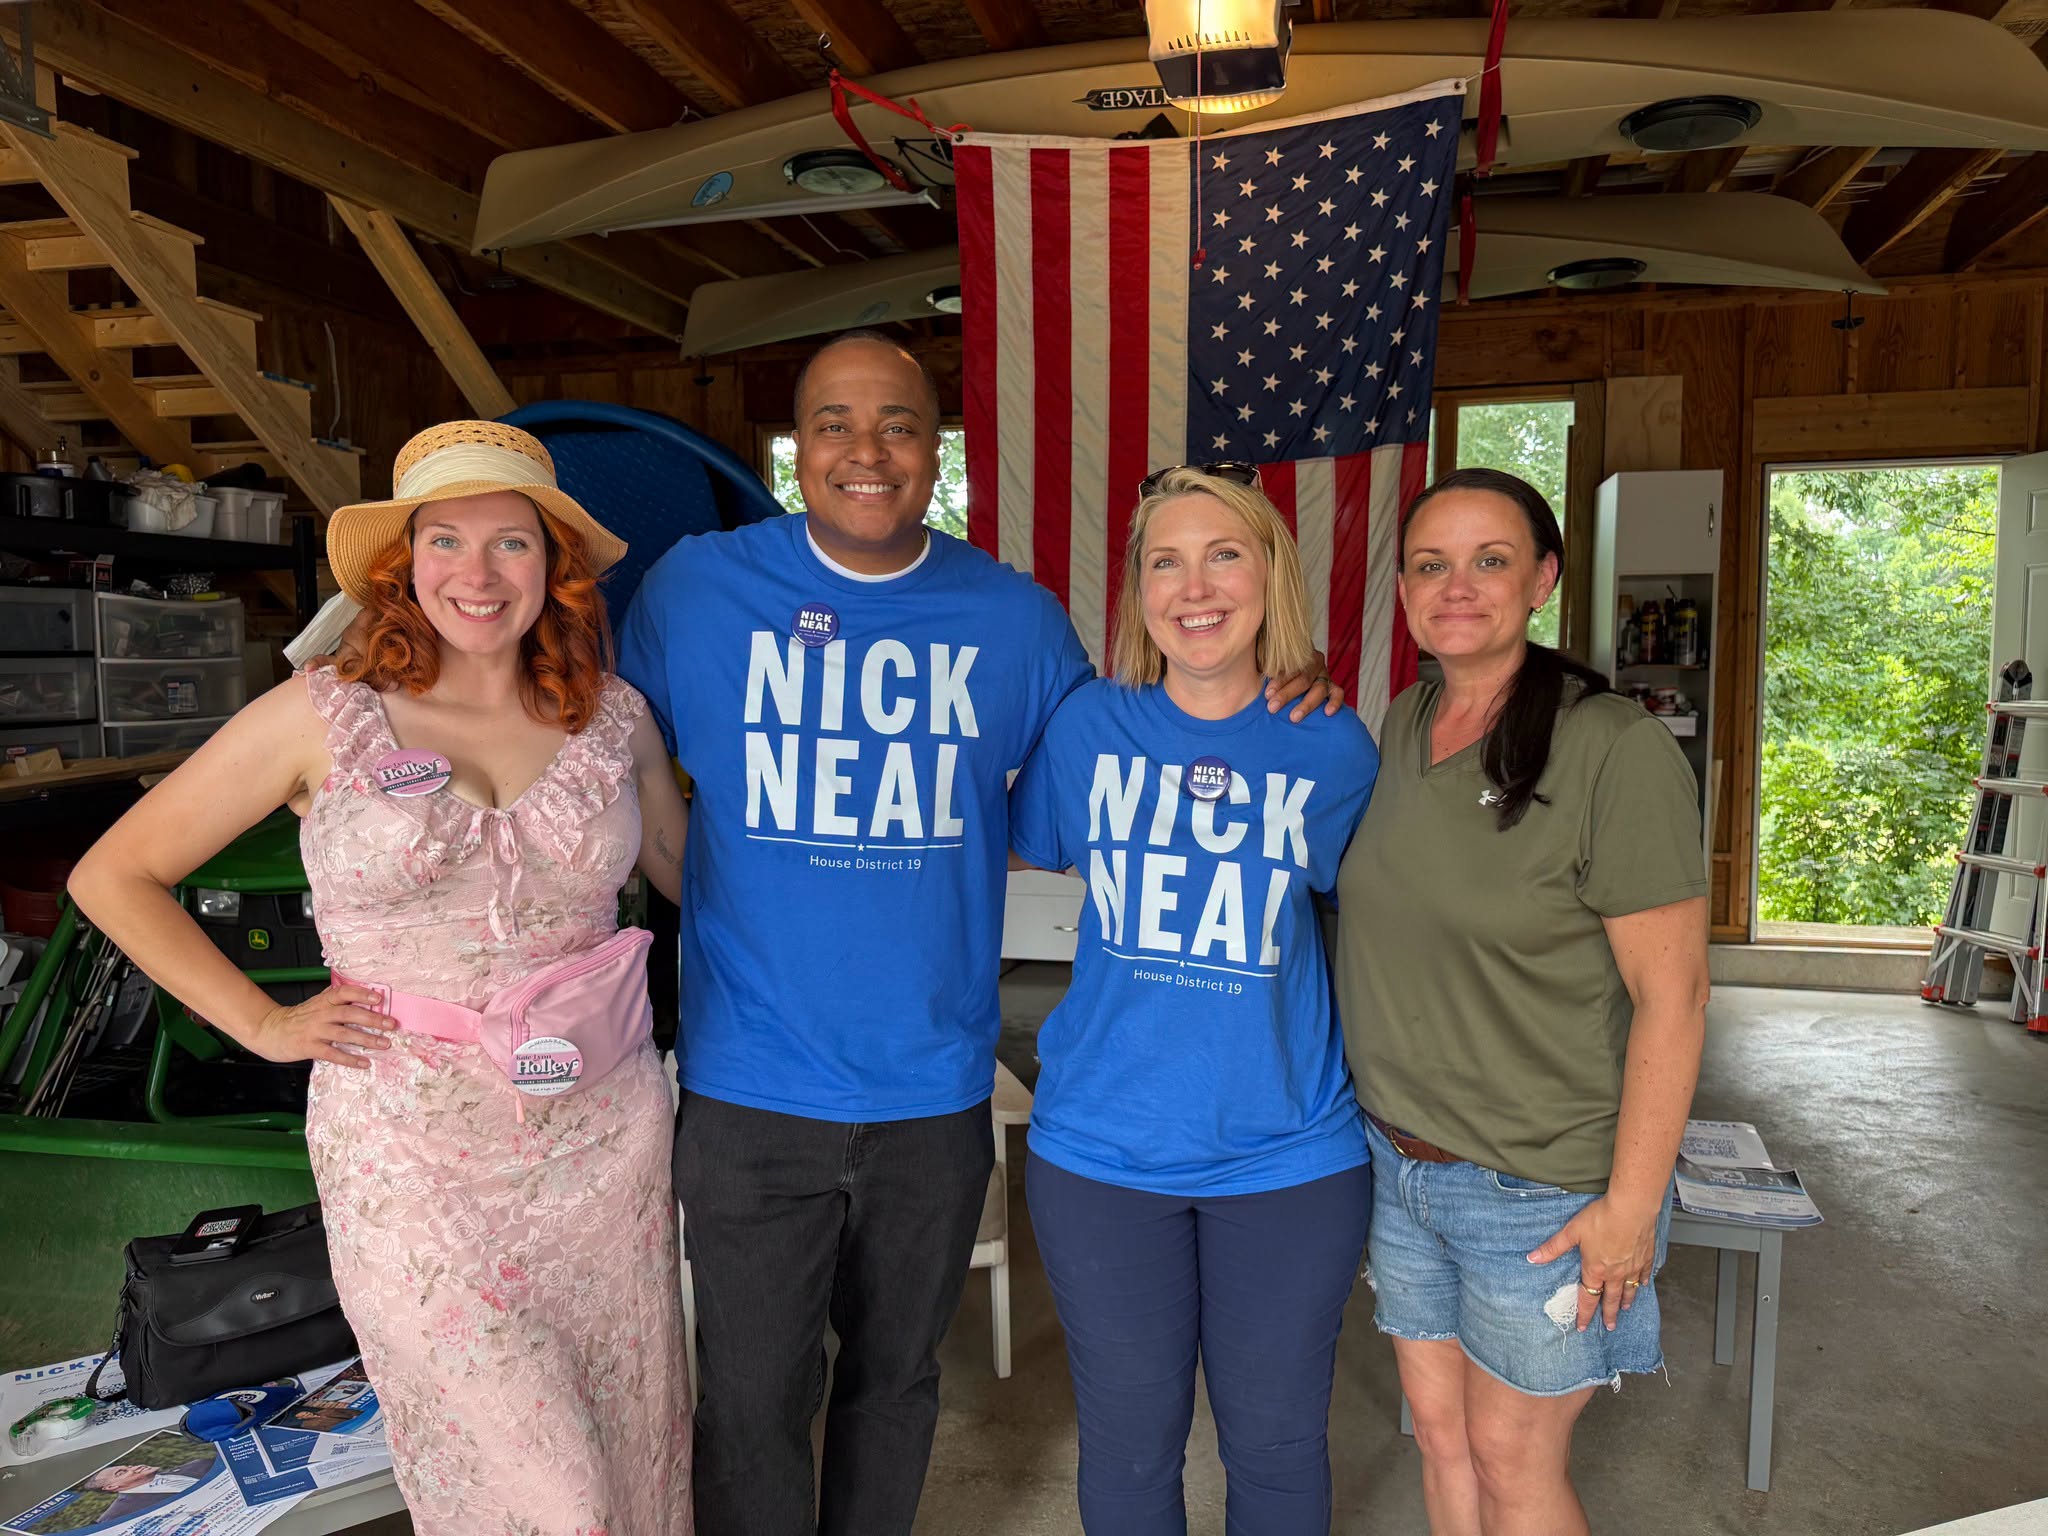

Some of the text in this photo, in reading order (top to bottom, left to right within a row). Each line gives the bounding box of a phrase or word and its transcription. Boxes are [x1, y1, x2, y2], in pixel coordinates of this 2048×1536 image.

[799, 619, 830, 632] NEAL
[801, 610, 832, 624] NICK
[744, 631, 980, 738] NICK
[380, 758, 442, 782] Holley
[1193, 774, 1224, 785] NEAL
[1194, 765, 1226, 776] NICK
[745, 731, 964, 839] NEAL
[1088, 754, 1316, 869] NICK
[809, 855, 922, 870] House District 19
[1090, 849, 1291, 966] NEAL
[1133, 968, 1242, 995] House District 19
[516, 1058, 580, 1078] Holley
[14, 1361, 86, 1382] NICK
[10, 1494, 71, 1526] NICK NEAL
